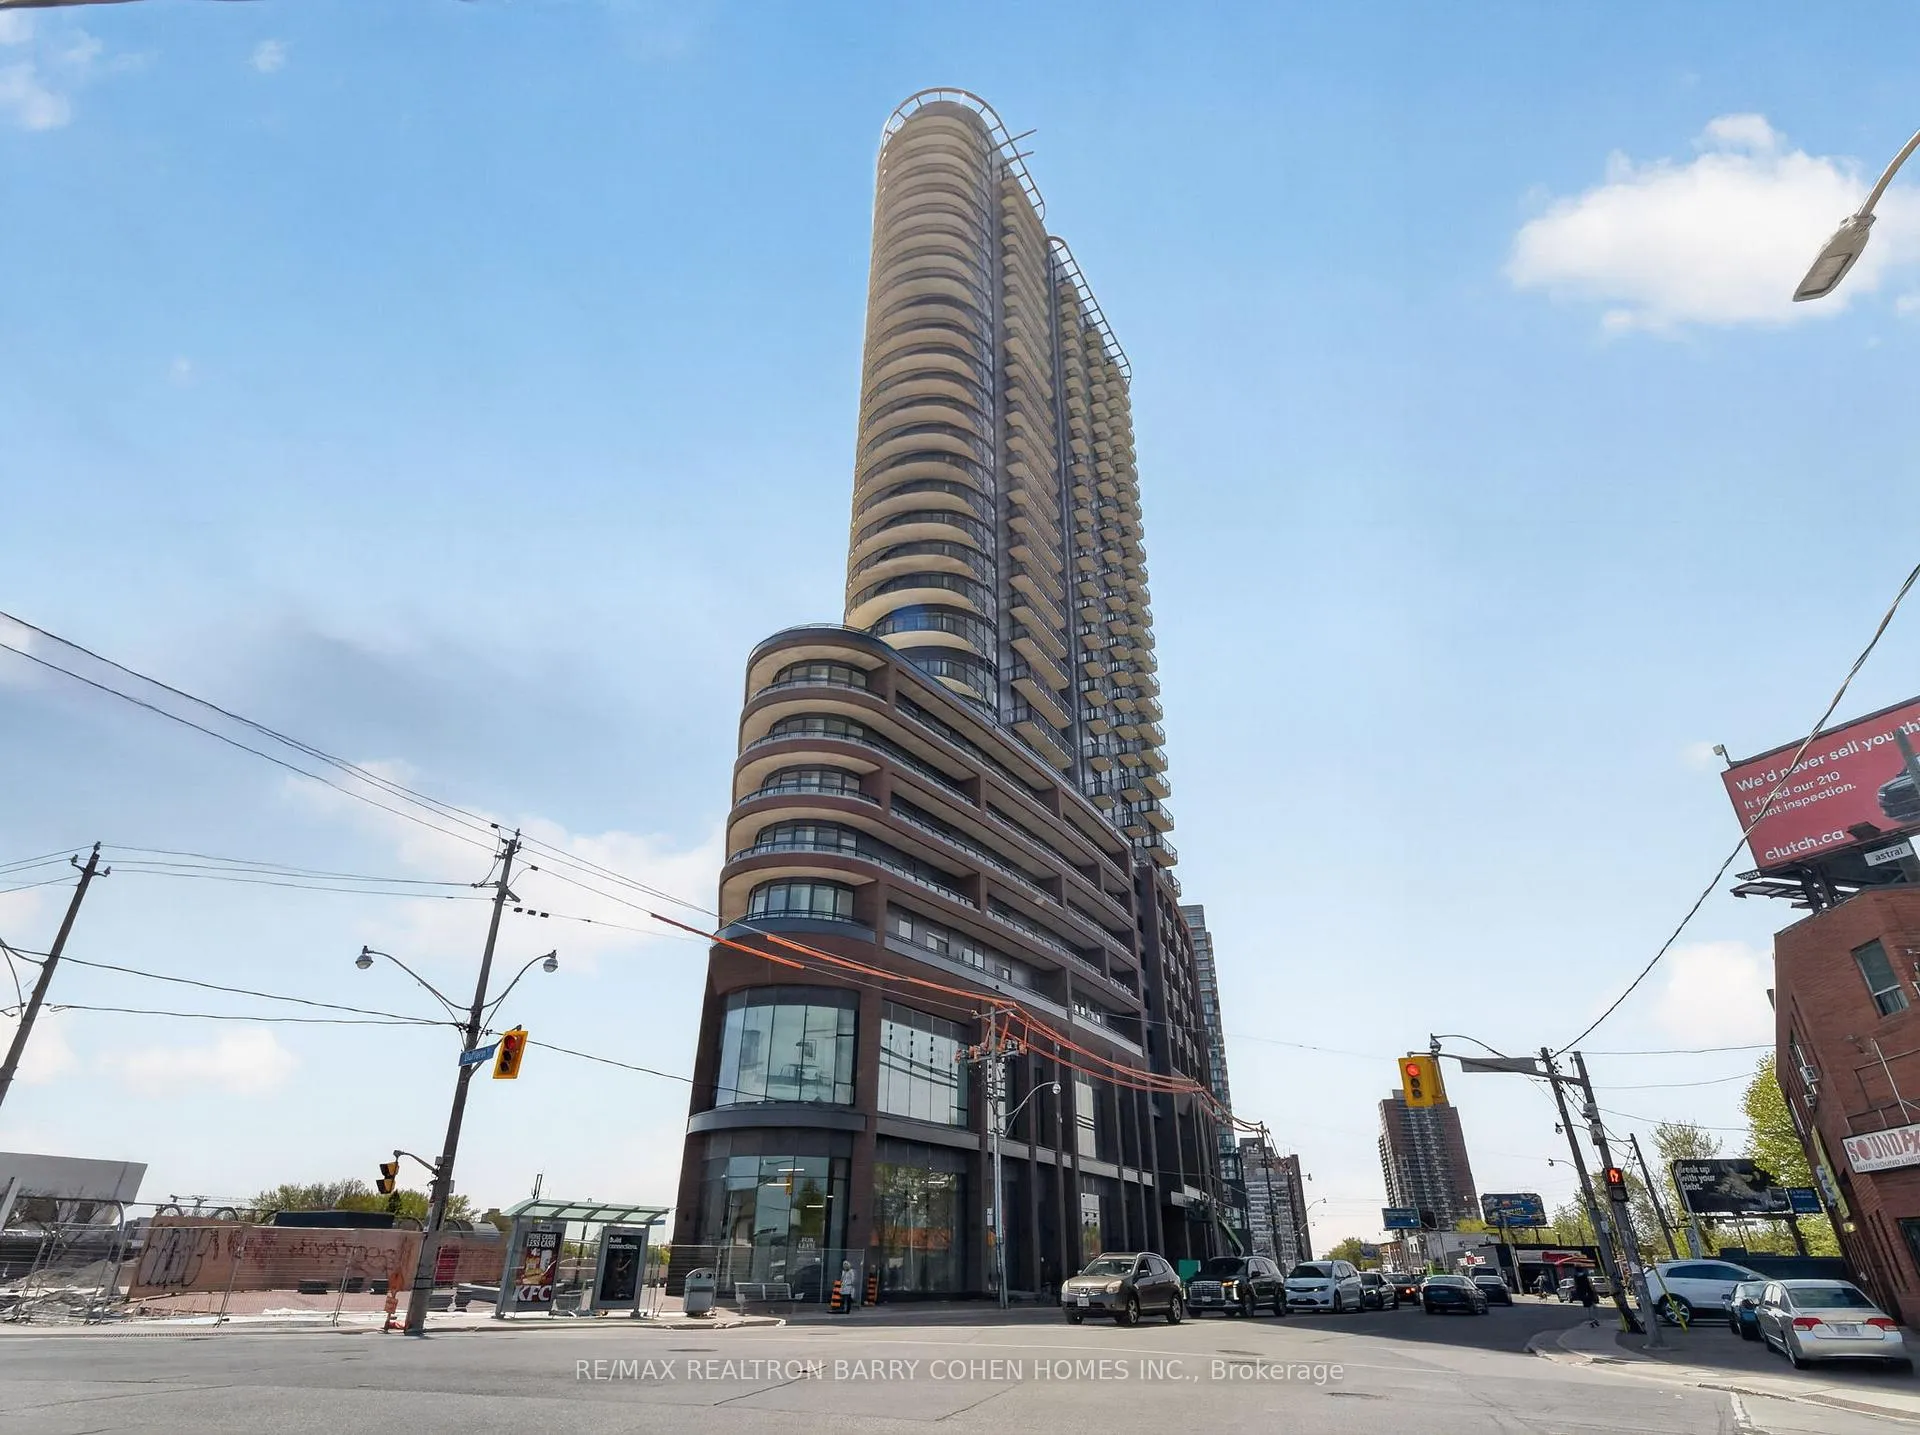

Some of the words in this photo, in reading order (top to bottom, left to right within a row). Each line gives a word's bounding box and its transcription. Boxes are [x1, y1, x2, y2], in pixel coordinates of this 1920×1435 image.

[1736, 770, 1777, 792] We'd
[1780, 754, 1825, 778] never
[1829, 740, 1859, 761] sell
[1861, 731, 1895, 752] you
[1744, 799, 1755, 809] It
[1756, 787, 1790, 805] faed
[1793, 780, 1815, 793] our
[1816, 771, 1840, 786] 210
[1783, 784, 1857, 808] inspection.
[1765, 829, 1845, 860] clutch.ca
[1875, 847, 1904, 862] astral
[514, 1285, 552, 1301] KFC
